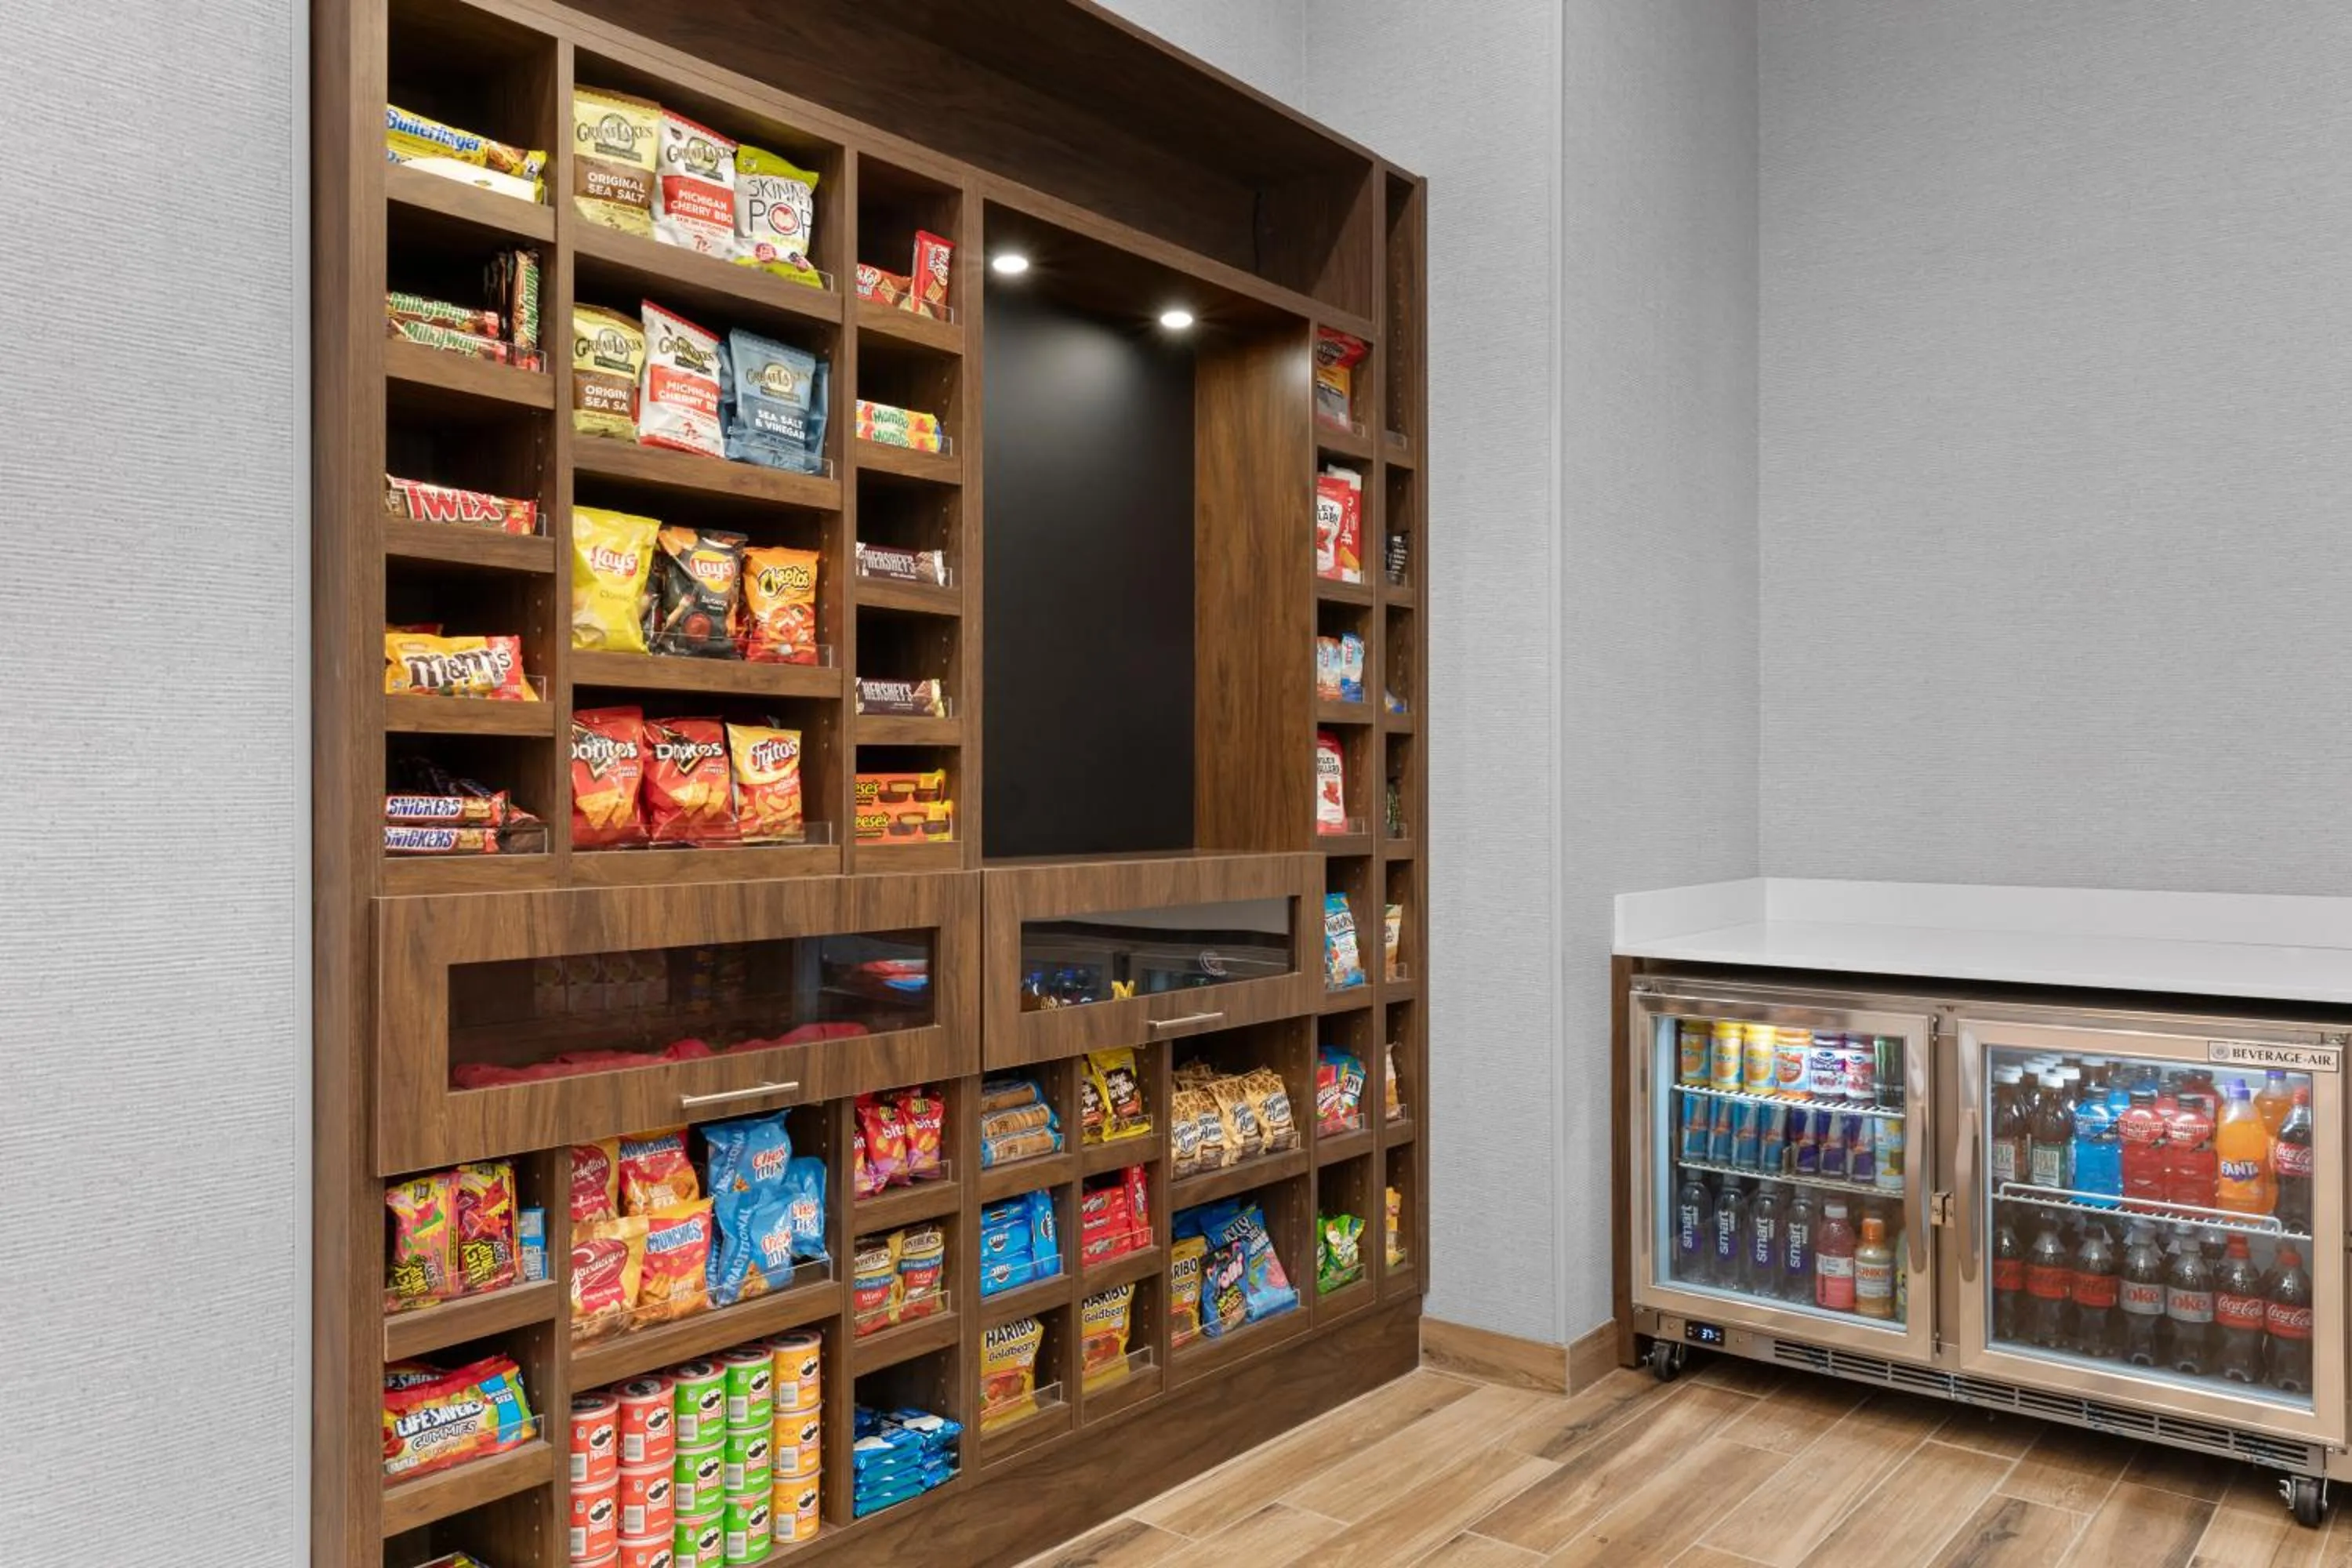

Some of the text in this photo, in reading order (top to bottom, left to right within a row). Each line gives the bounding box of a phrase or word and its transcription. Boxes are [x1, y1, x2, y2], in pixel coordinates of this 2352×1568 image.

[588, 172, 646, 193] ORIGINAL
[588, 183, 645, 204] SEA SALT
[671, 201, 710, 217] CHERRY
[679, 189, 728, 211] MICHIGAN
[585, 384, 627, 401] ORIGIN
[658, 390, 703, 406] CHERRY
[666, 380, 717, 402] MICHIGAN
[584, 396, 628, 412] SEA SA
[757, 409, 804, 430] SEA SALT
[766, 420, 805, 441] VINEGAR
[749, 739, 798, 773] Fritos
[388, 798, 461, 815] SNICKERS
[1682, 1204, 1693, 1249] smart
[1719, 1210, 1729, 1254] smart
[1756, 1216, 1768, 1264] smart
[1790, 1222, 1802, 1269] smart
[1173, 1257, 1198, 1279] RIBO
[985, 1317, 1036, 1348] HARIBO
[412, 1421, 477, 1450] GUMMIES
